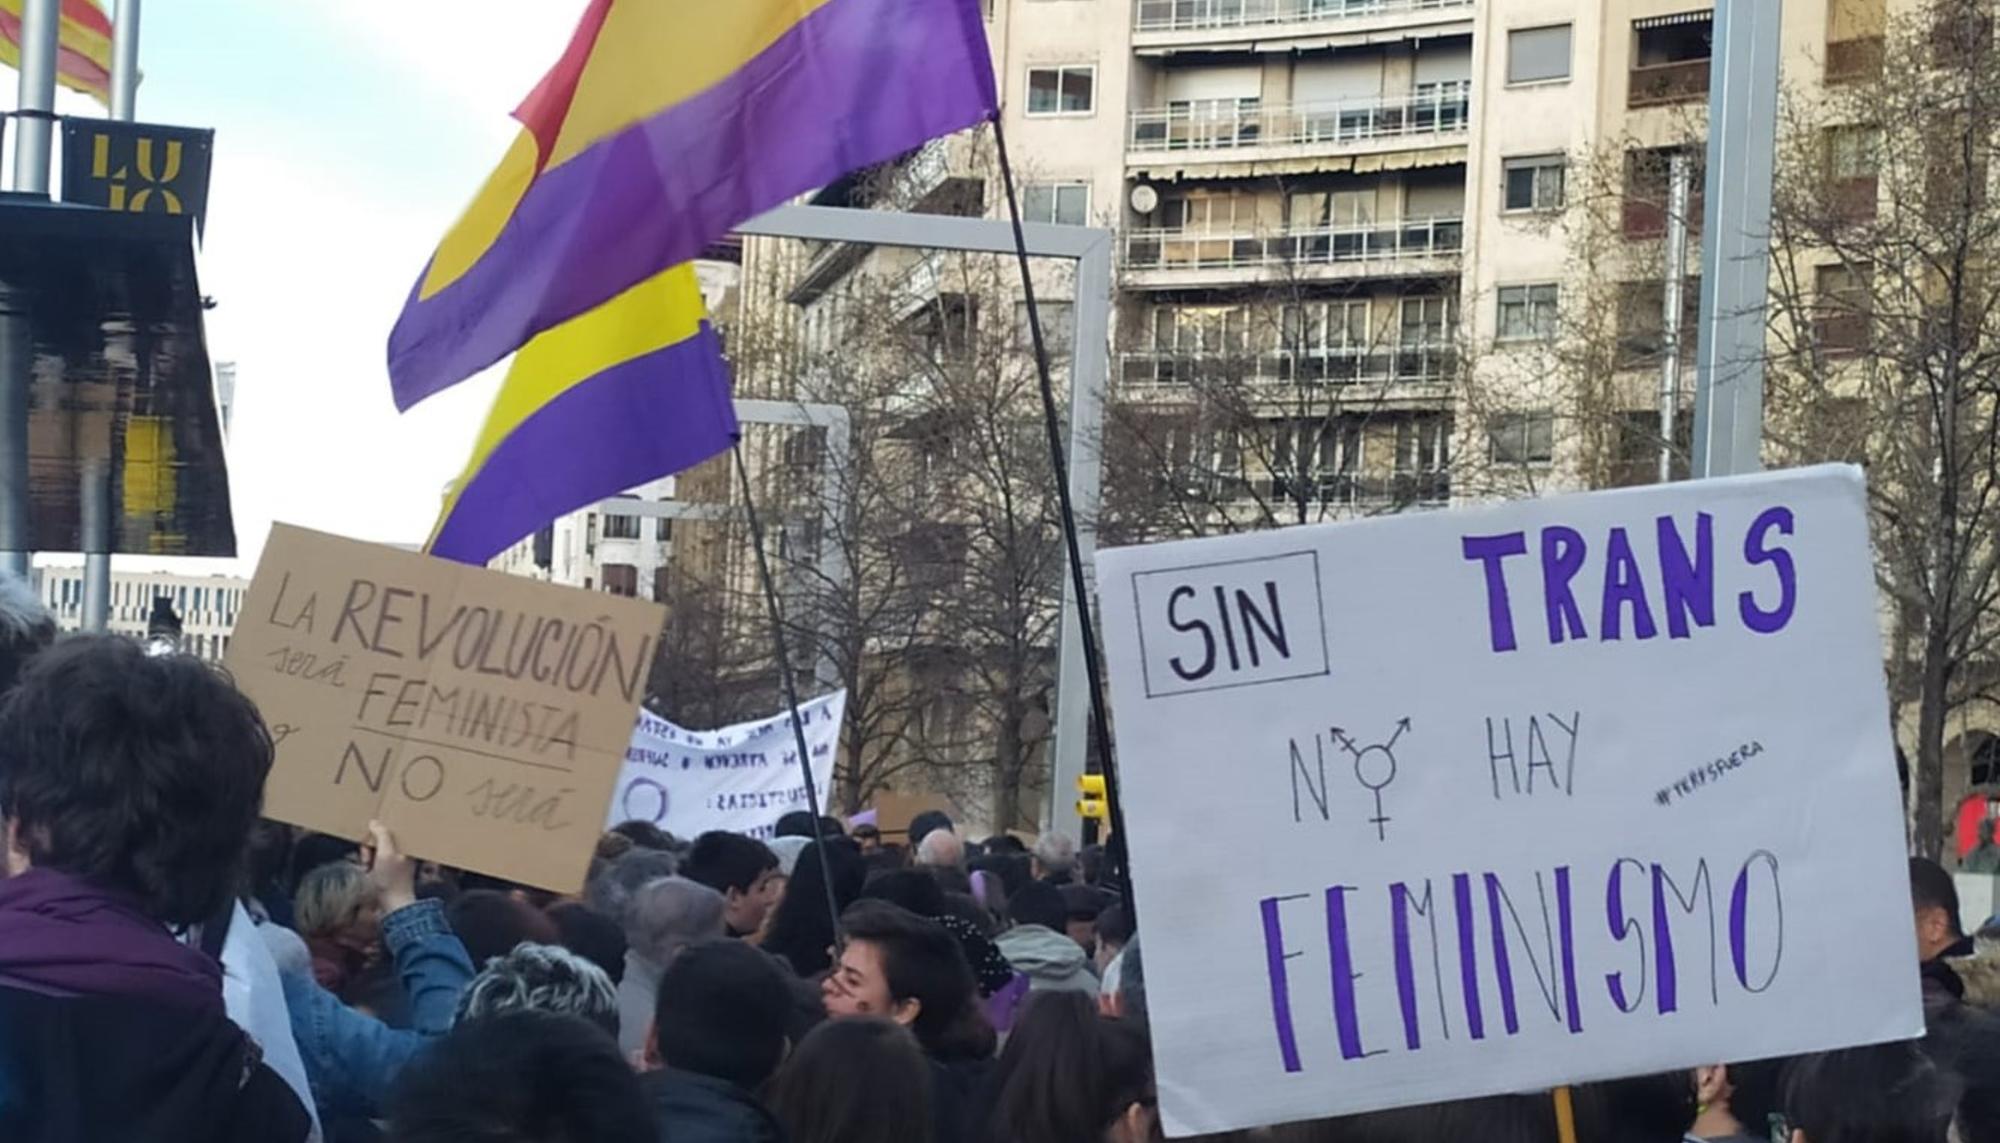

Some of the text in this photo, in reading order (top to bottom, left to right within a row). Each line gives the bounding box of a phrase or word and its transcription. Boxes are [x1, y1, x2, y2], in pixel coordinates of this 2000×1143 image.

[91, 134, 183, 183] LU
[268, 570, 652, 704] LA REVOLUCIÓN
[1168, 506, 1798, 680] SIN TRANS
[357, 671, 580, 761] FEMINISTA
[1486, 711, 1580, 799] HAY
[333, 741, 445, 802] NO
[1259, 849, 1783, 1073] FEMINISMO
